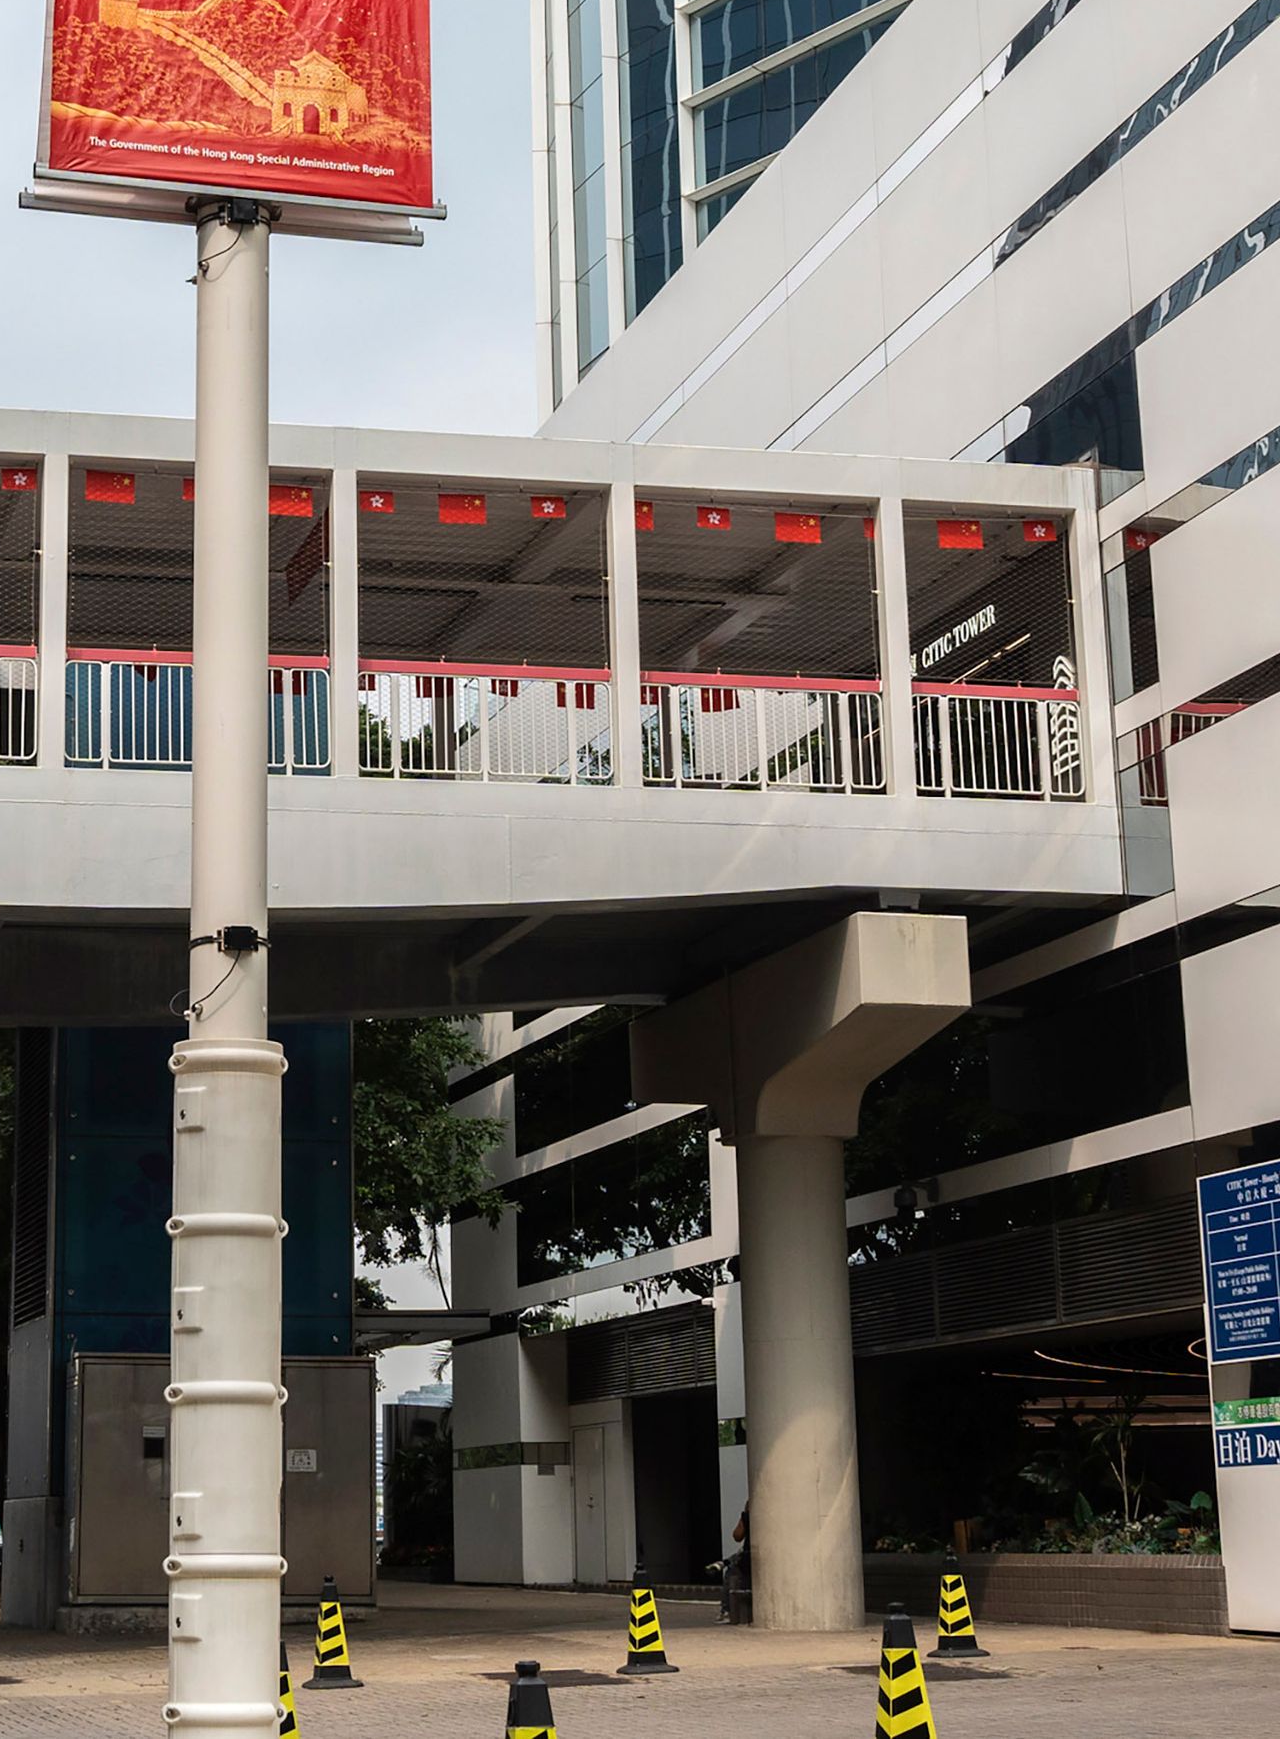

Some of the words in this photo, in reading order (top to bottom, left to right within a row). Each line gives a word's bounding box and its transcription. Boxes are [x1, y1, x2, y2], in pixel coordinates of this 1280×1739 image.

[89, 136, 107, 147] The
[109, 138, 169, 154] Government
[171, 144, 182, 155] of
[183, 146, 200, 157] the
[202, 147, 228, 162] Hong
[229, 150, 256, 165] Kong
[256, 153, 291, 167] Special
[292, 156, 361, 174] Administrative
[362, 165, 396, 177] Region
[921, 634, 952, 669] CITIC
[953, 604, 997, 651] TOWER
[1219, 1430, 1252, 1464] 日泊
